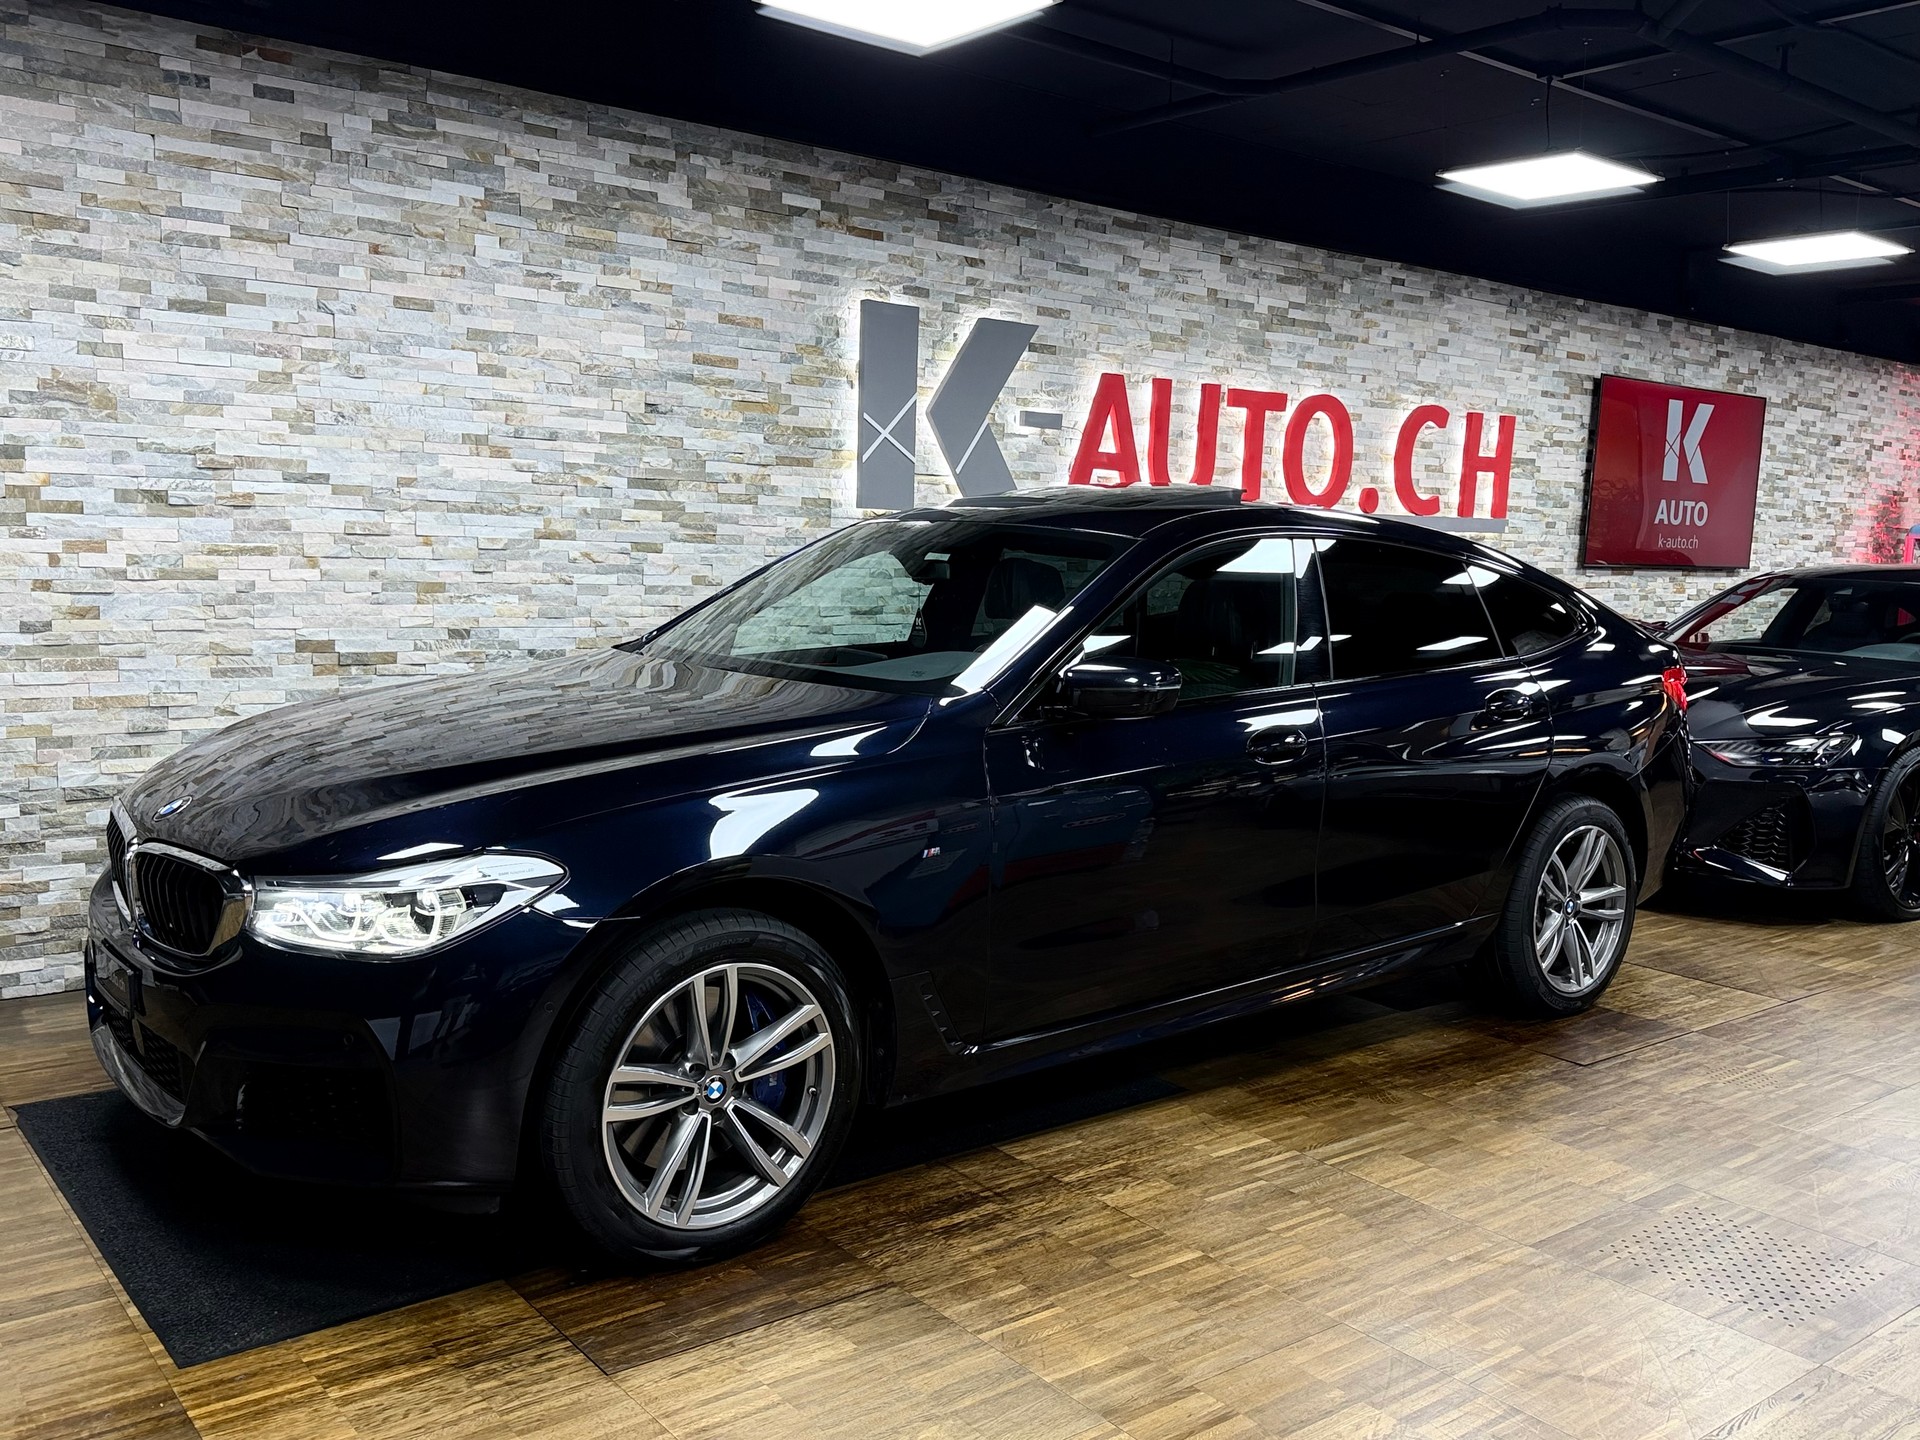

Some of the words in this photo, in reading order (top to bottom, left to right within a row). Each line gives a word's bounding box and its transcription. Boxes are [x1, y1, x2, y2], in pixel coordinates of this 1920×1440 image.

[856, 298, 1516, 519] K-AUTO.CH
[1662, 399, 1715, 485] K
[1654, 499, 1709, 527] AUTO
[1657, 534, 1699, 550] k-auto.ch
[698, 936, 750, 954] TURANZA
